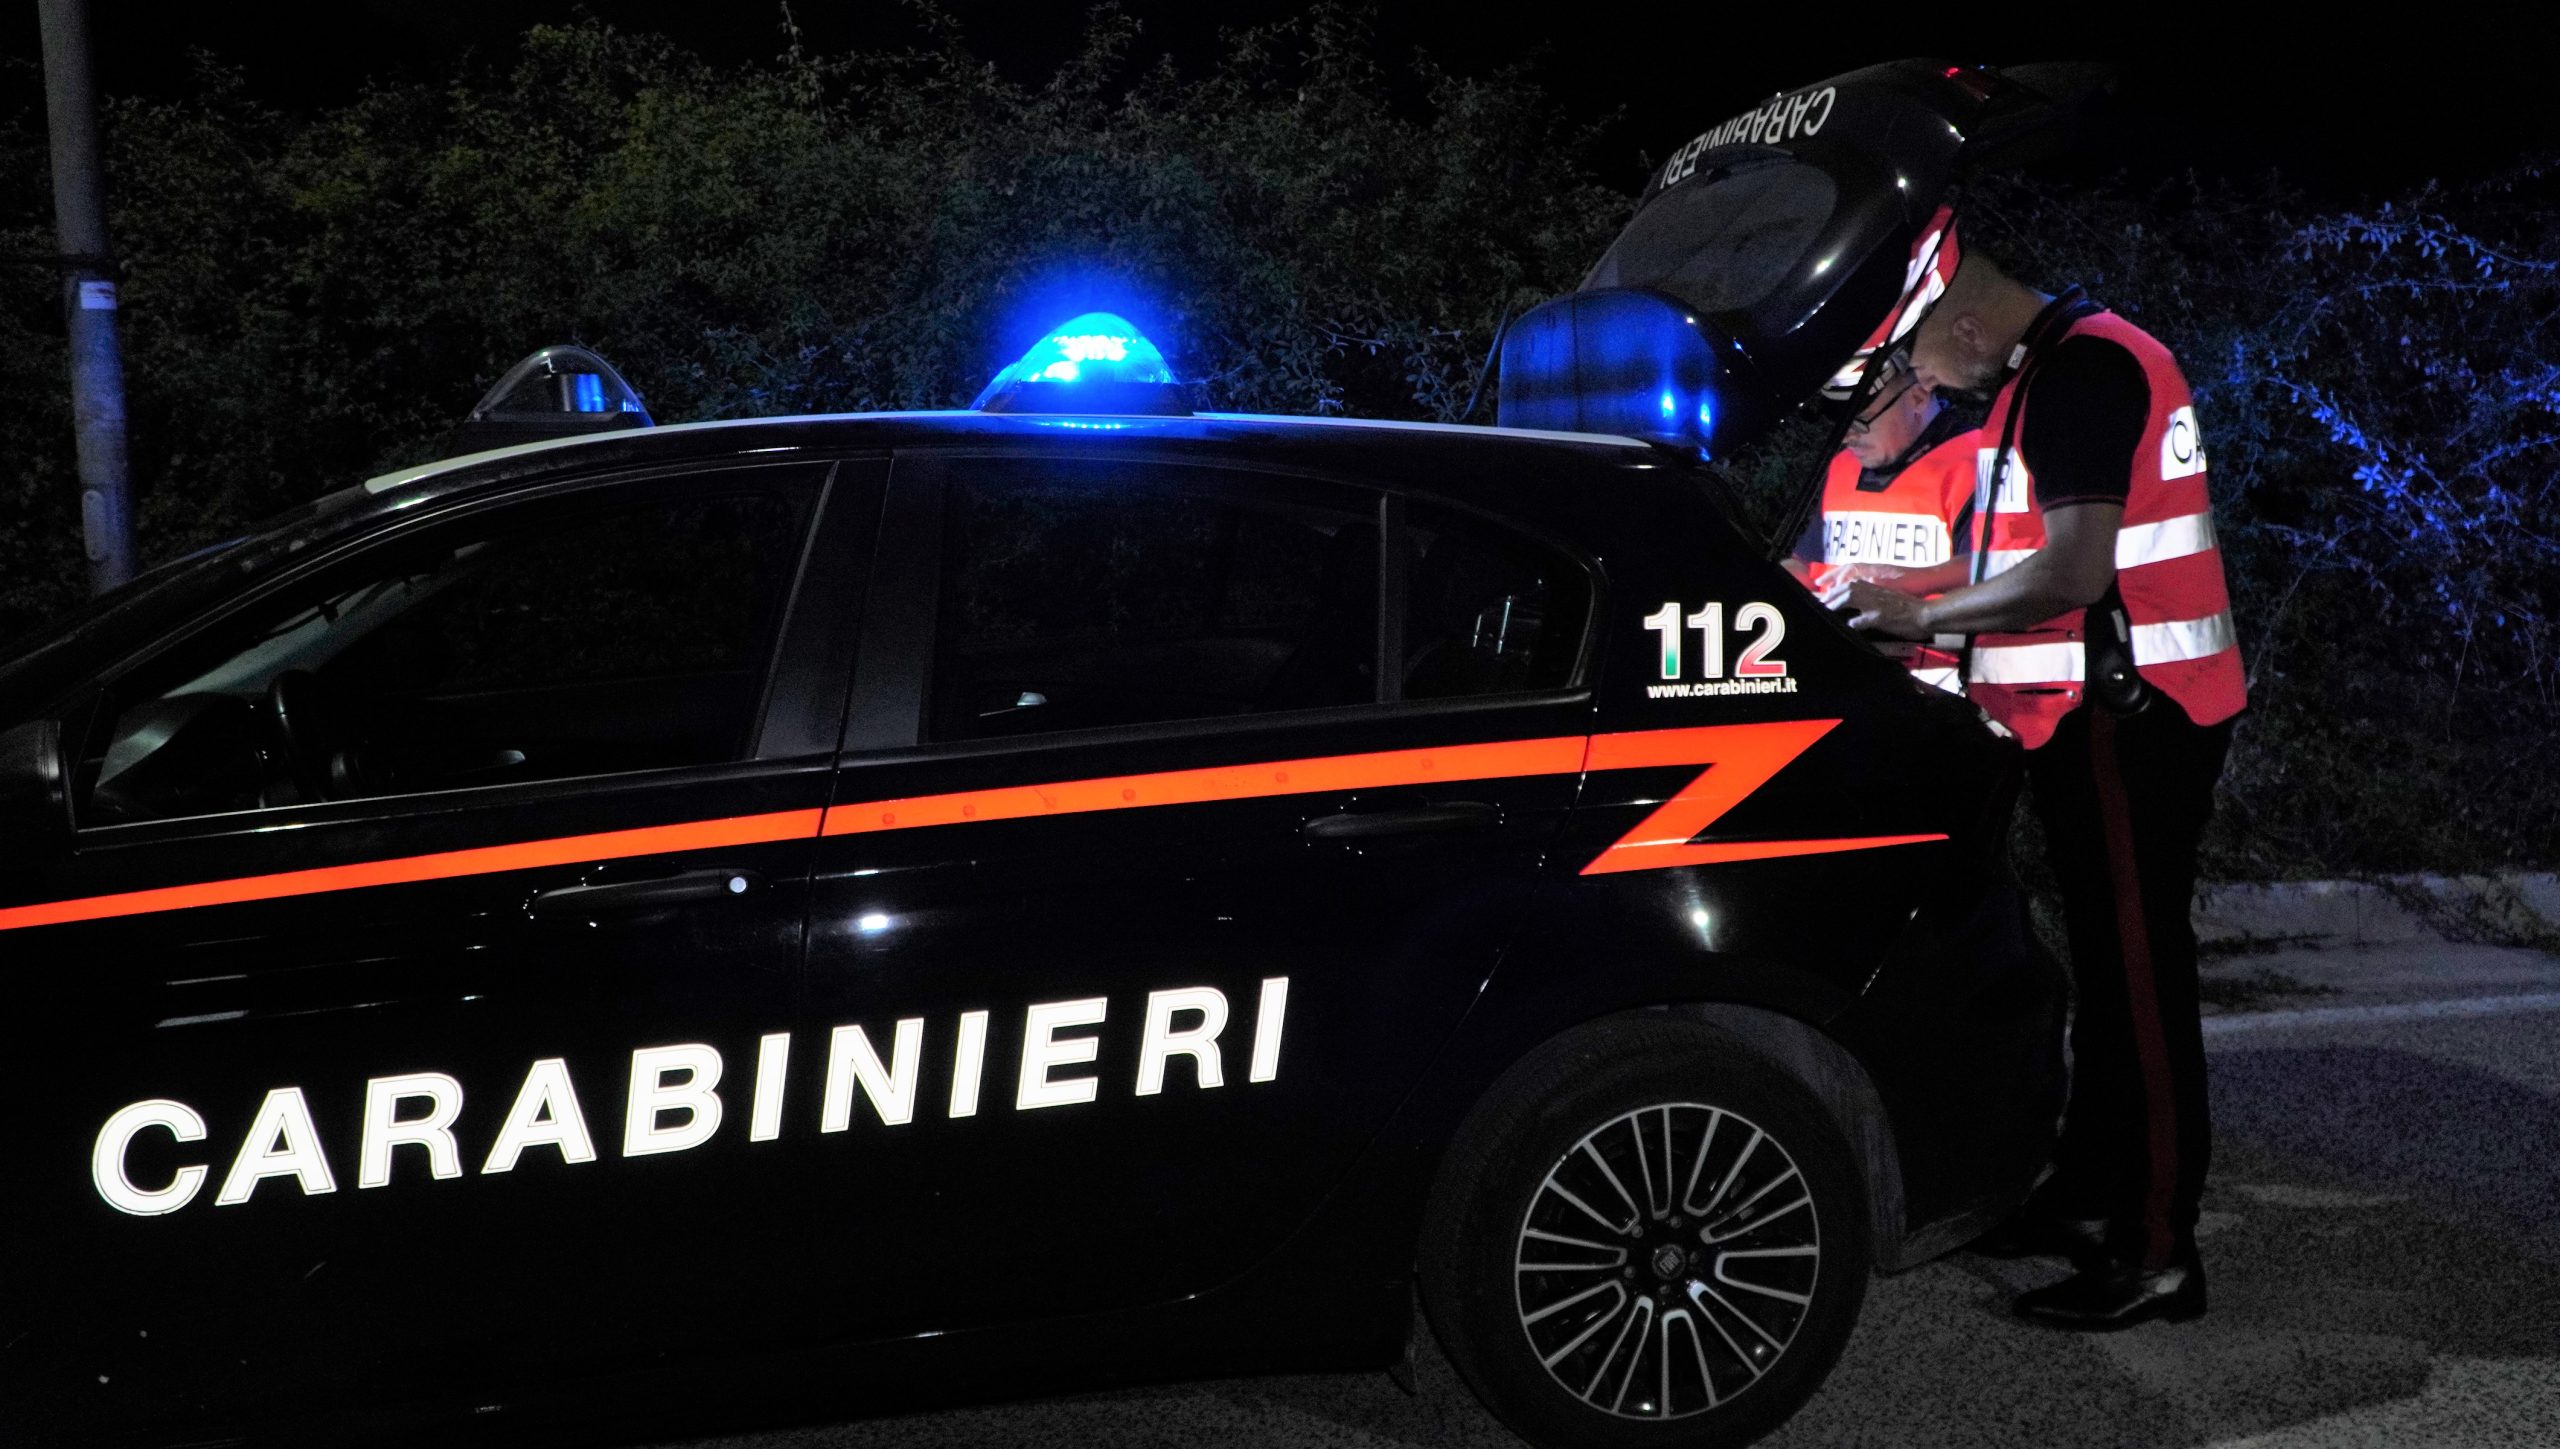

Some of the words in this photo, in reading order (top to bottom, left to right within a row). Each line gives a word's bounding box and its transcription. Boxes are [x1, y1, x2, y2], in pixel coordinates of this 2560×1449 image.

[1824, 519, 1939, 562] ARABINIERI
[1643, 602, 1787, 679] 112
[1647, 677, 1798, 698] www.carabinieri.it
[91, 976, 1289, 1216] CARABINIERI
